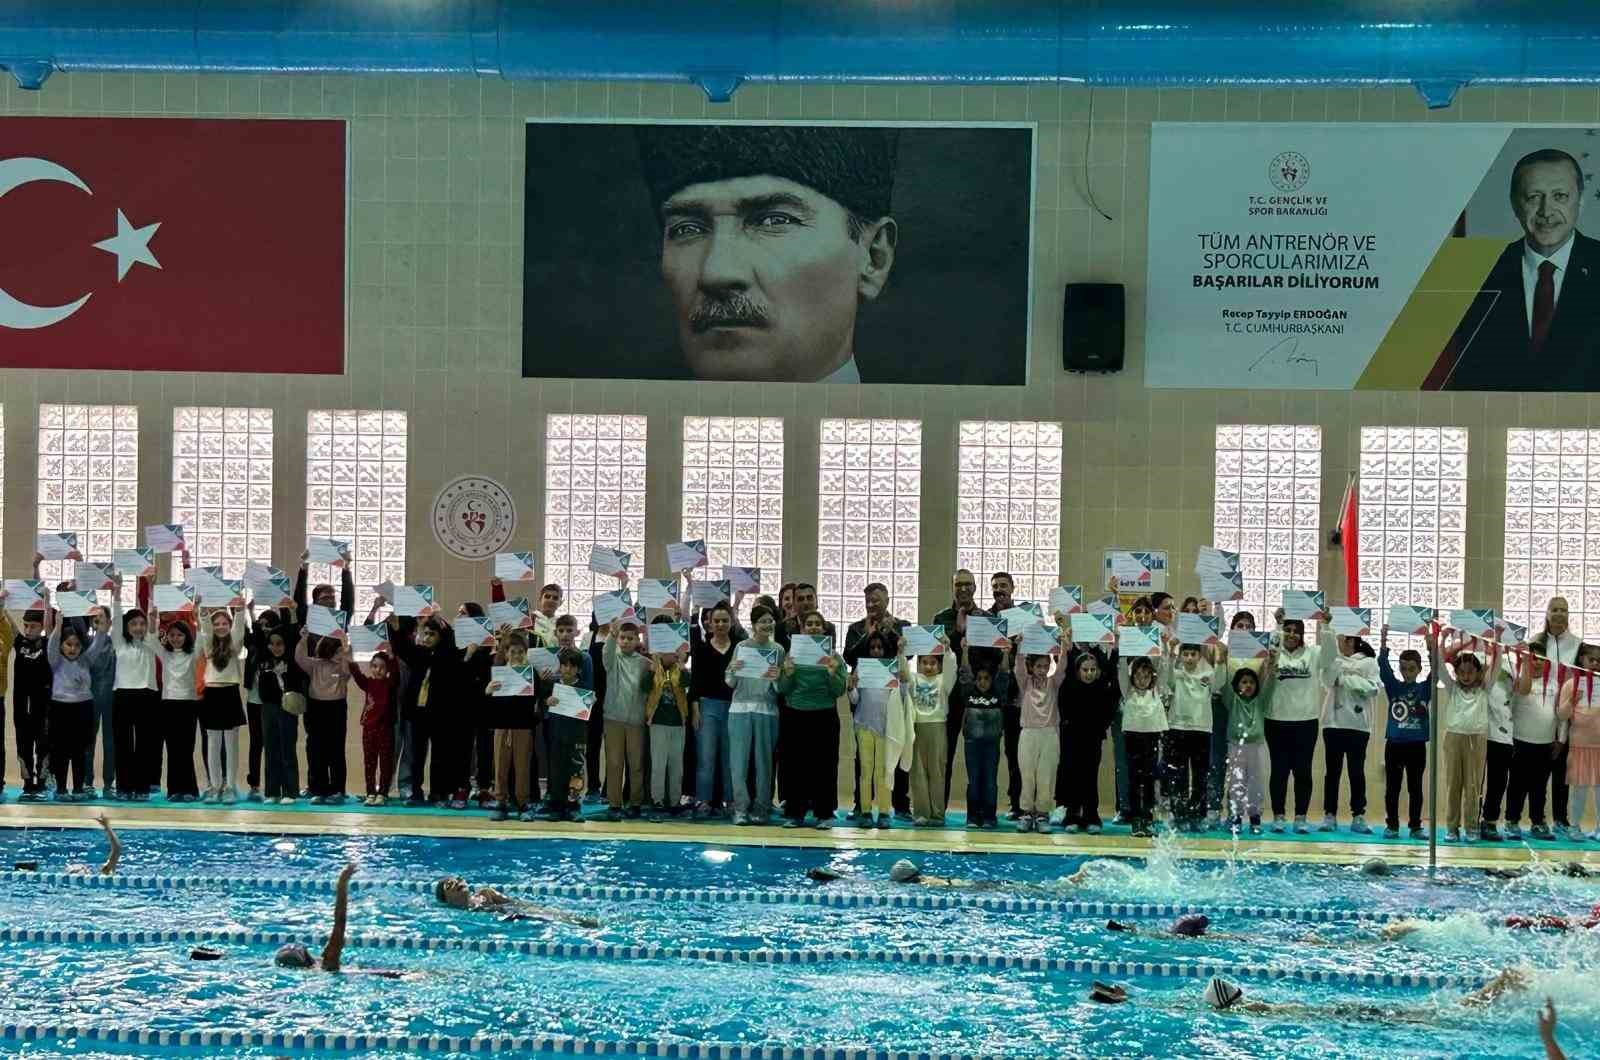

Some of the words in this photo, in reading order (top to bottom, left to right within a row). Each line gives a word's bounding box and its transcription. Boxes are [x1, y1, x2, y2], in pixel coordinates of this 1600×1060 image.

[1248, 196, 1266, 205] T.C.
[1268, 194, 1313, 206] GENÇLİK
[1315, 196, 1328, 205] VE
[1248, 207, 1274, 216] SPOR
[1275, 206, 1328, 216] BAKANLIĞI
[1198, 231, 1240, 250] TÜM
[1246, 232, 1349, 251] ANTRENÖR
[1353, 235, 1377, 251] VE
[1203, 253, 1369, 270] SPORCULARIMIZA
[1193, 275, 1284, 291] BAŞARILAR
[1287, 273, 1379, 289] DİLİYORUM
[1222, 309, 1254, 319] Recep
[1255, 309, 1291, 320] Tayyip
[1293, 308, 1348, 320] ERDOĞAN
[1225, 323, 1242, 333] T.C.
[1245, 322, 1344, 335] CUMHURBAŞKANI
